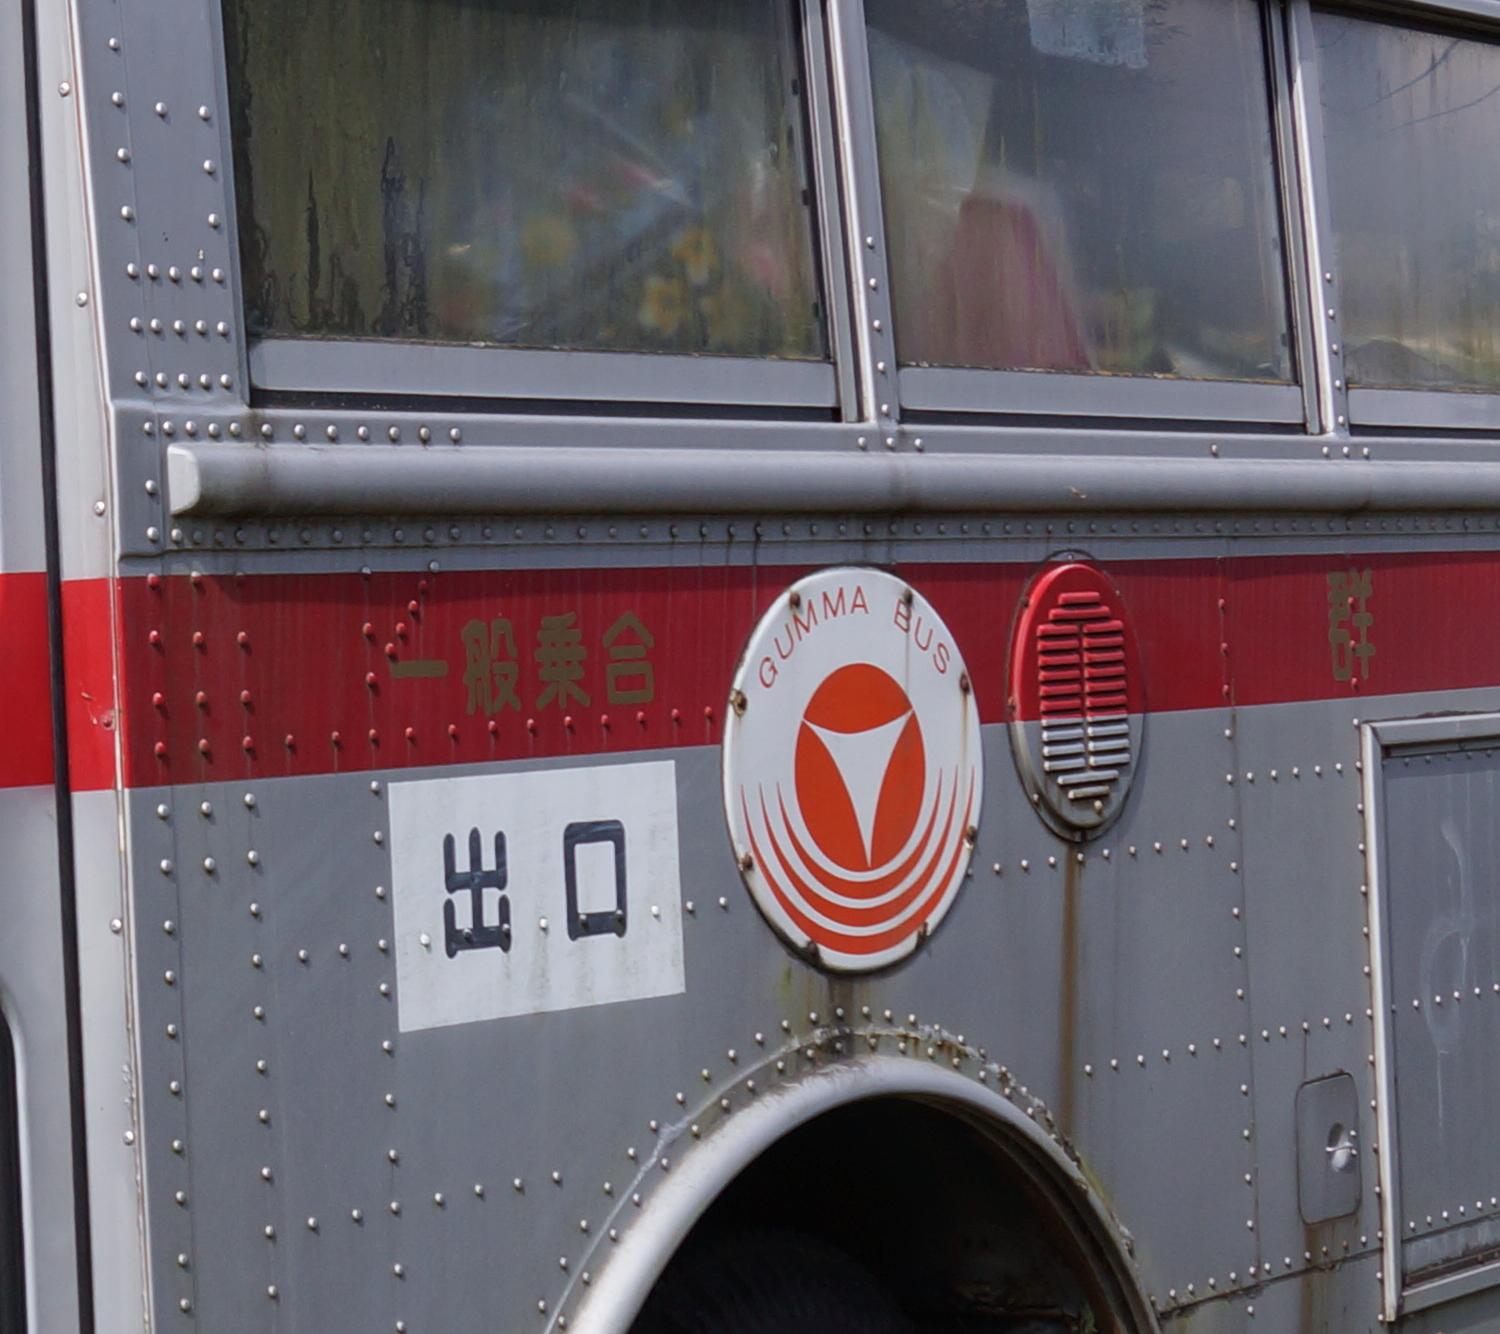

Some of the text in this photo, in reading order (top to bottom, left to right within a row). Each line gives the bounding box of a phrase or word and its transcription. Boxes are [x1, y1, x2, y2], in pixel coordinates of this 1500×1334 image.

[390, 610, 655, 717] 一般乗合
[758, 585, 951, 689] GUMMA BUS
[442, 818, 629, 960] 出口
